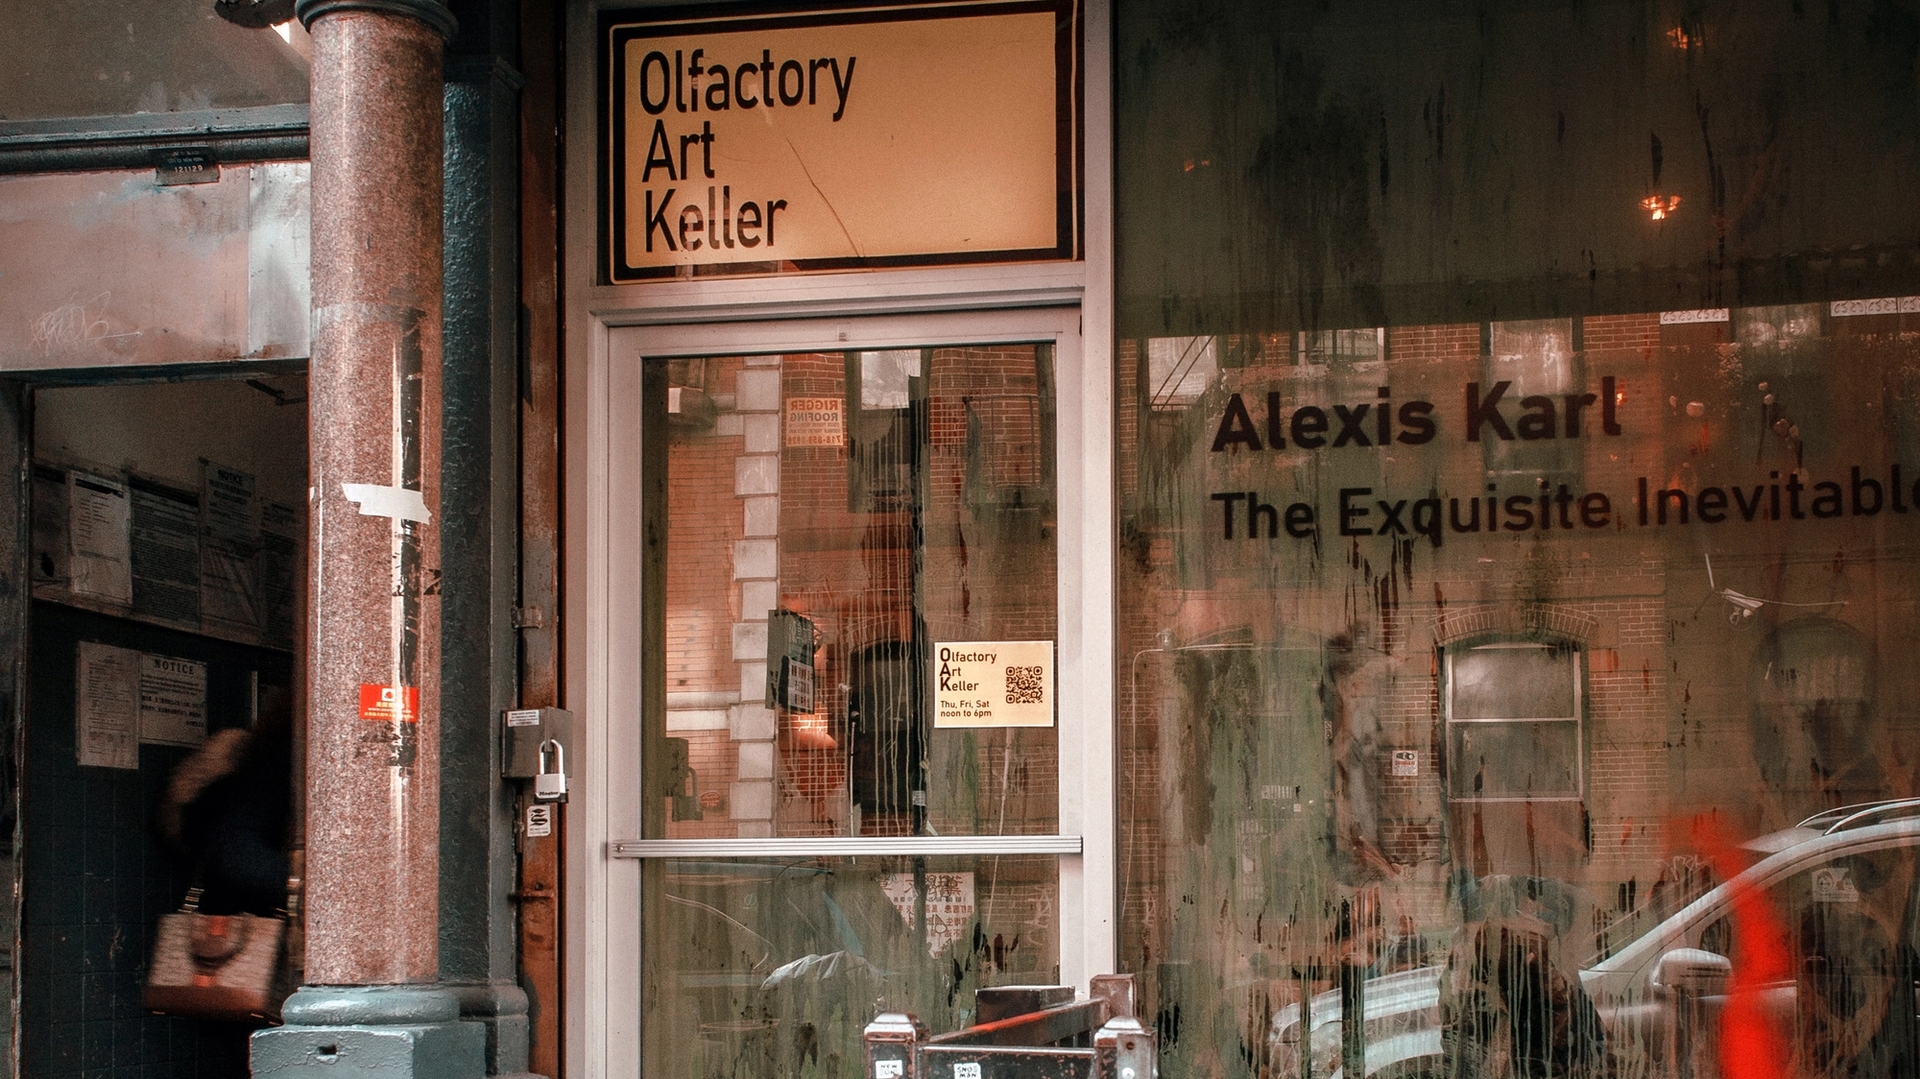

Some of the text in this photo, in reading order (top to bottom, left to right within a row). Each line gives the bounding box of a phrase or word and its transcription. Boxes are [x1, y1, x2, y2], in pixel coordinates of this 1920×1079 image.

[640, 49, 856, 122] Olfactory
[642, 119, 715, 182] Art
[645, 185, 788, 252] Keller
[1211, 376, 1621, 452] Alexis Karl
[1211, 464, 1920, 548] The Exquisite Inevitabl
[939, 647, 997, 664] Olfactory
[154, 659, 195, 675] NOTICE
[939, 662, 961, 677] Art
[939, 676, 979, 692] Keller
[940, 700, 990, 709] Thu, Fri, Sat
[973, 709, 992, 718] 6pm
